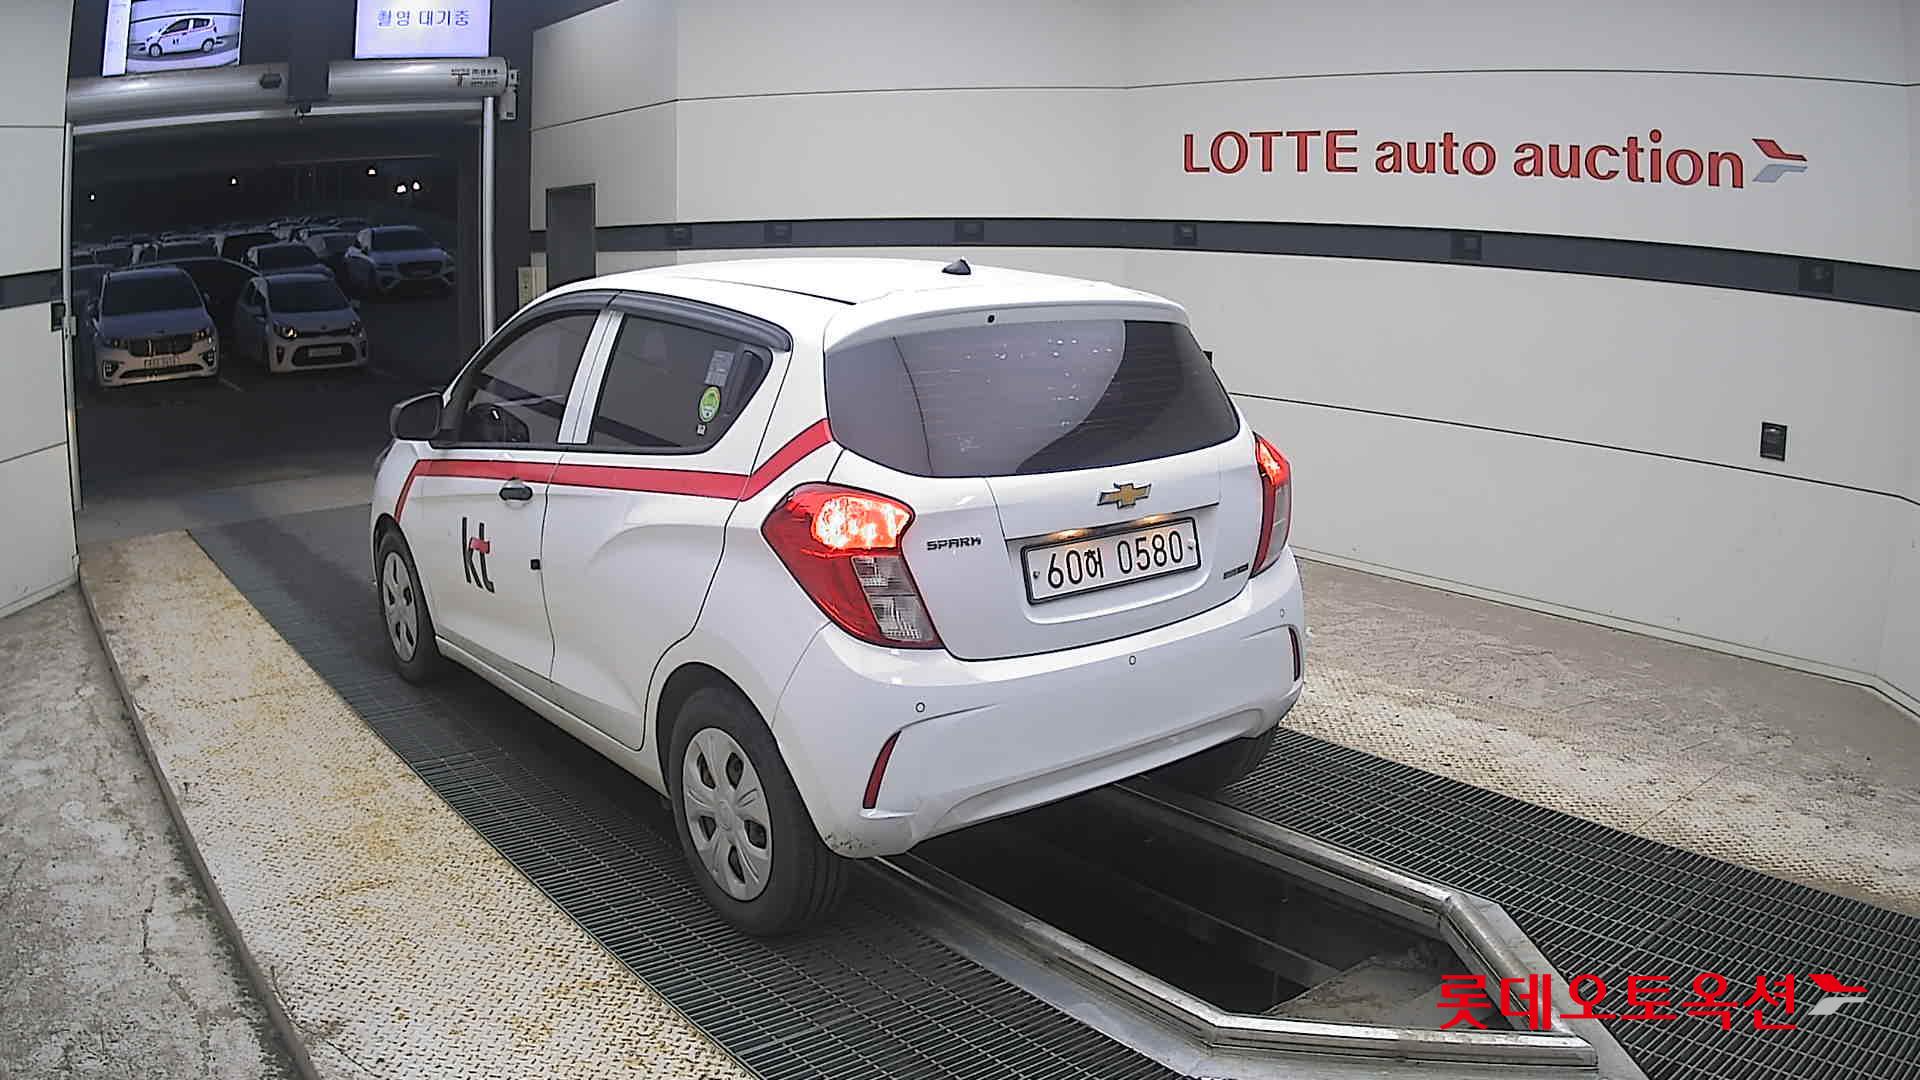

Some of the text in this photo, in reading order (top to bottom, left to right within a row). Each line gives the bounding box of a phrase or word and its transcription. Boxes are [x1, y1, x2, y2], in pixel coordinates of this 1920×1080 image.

[419, 9, 469, 26] 대기중
[1184, 129, 1744, 189] LOTTE auto auction
[462, 517, 495, 593] kt
[927, 537, 982, 551] SPARK
[1046, 547, 1105, 589] 60허
[1117, 530, 1184, 575] 0580
